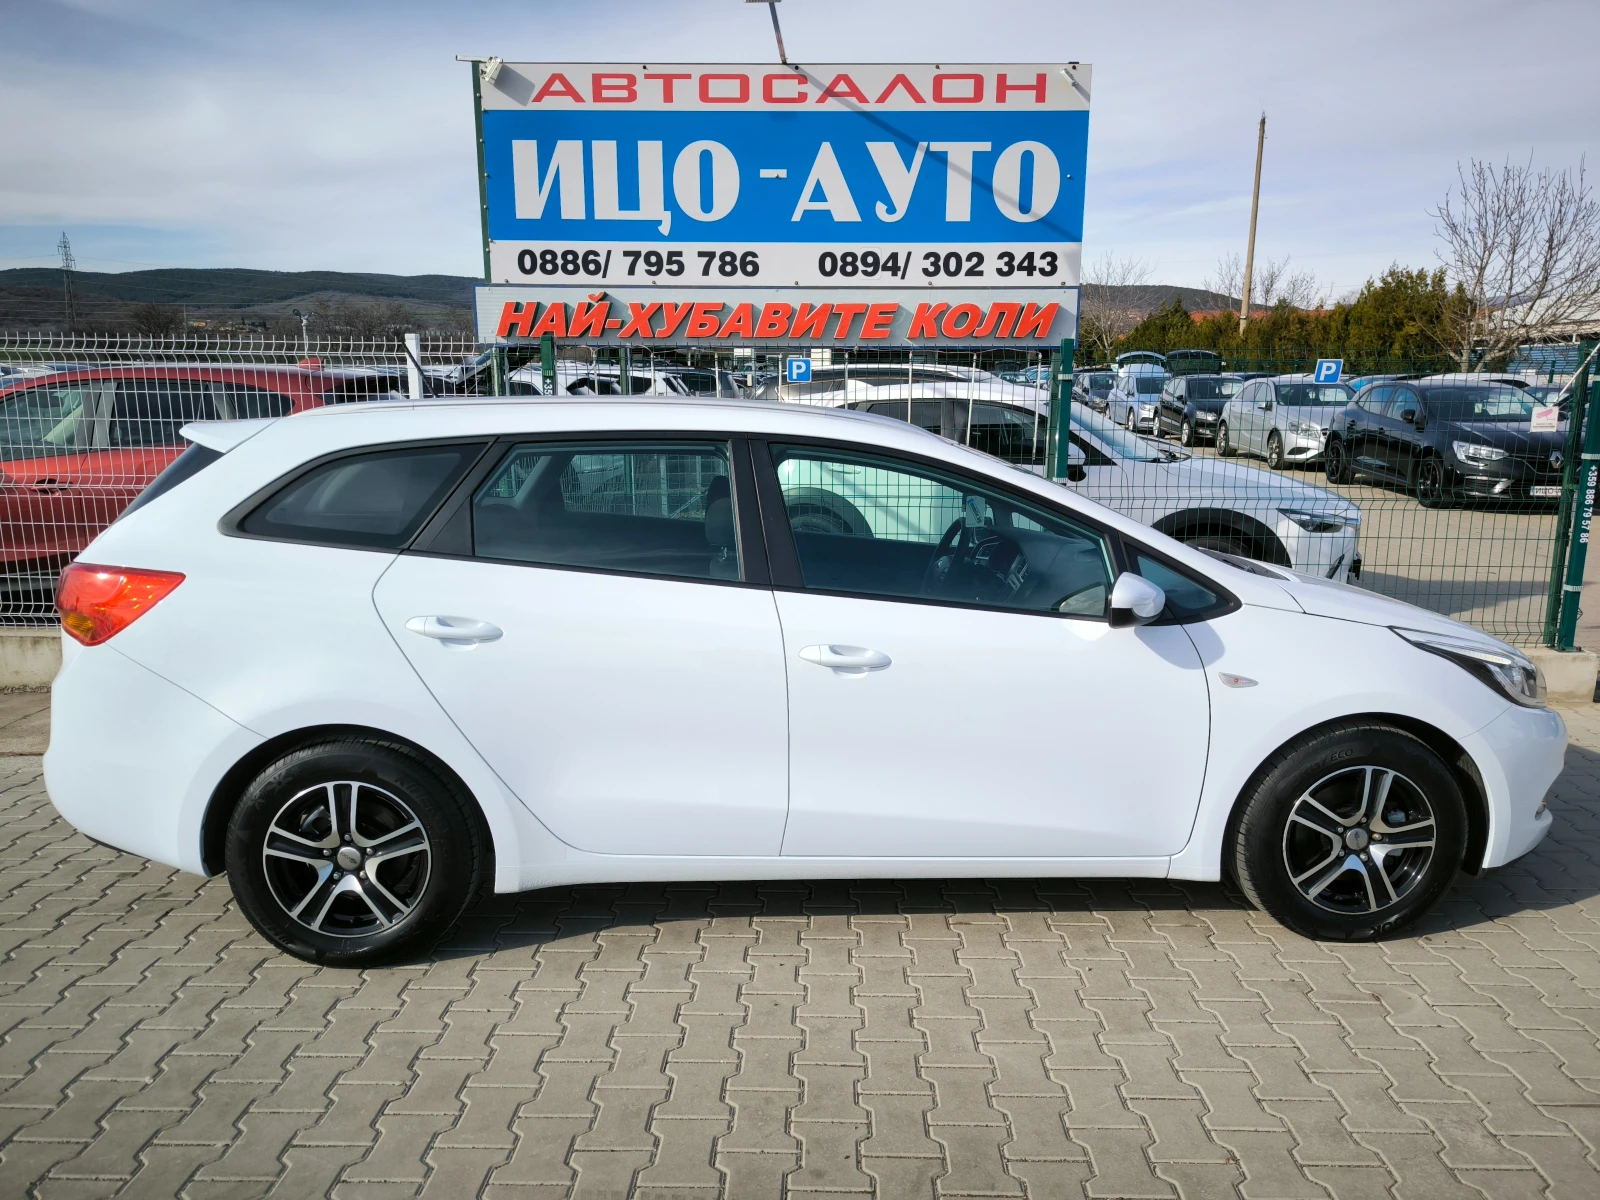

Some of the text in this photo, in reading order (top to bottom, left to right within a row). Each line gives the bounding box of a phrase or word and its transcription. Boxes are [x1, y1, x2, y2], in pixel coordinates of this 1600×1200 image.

[532, 73, 1047, 103] АВТОСАЛОН
[517, 249, 1058, 280] 0886/ 795 786 0894/ 302 343
[497, 293, 1060, 339] НАЙ-ХУБАВИТЕ КОЛИ
[792, 361, 807, 380] P
[1320, 362, 1337, 381] P
[544, 378, 553, 396] +35
[1587, 465, 1598, 487] +359
[1583, 507, 1593, 518] 79
[1581, 520, 1591, 531] 57
[1579, 532, 1589, 543] 86
[1330, 748, 1353, 761] ECO
